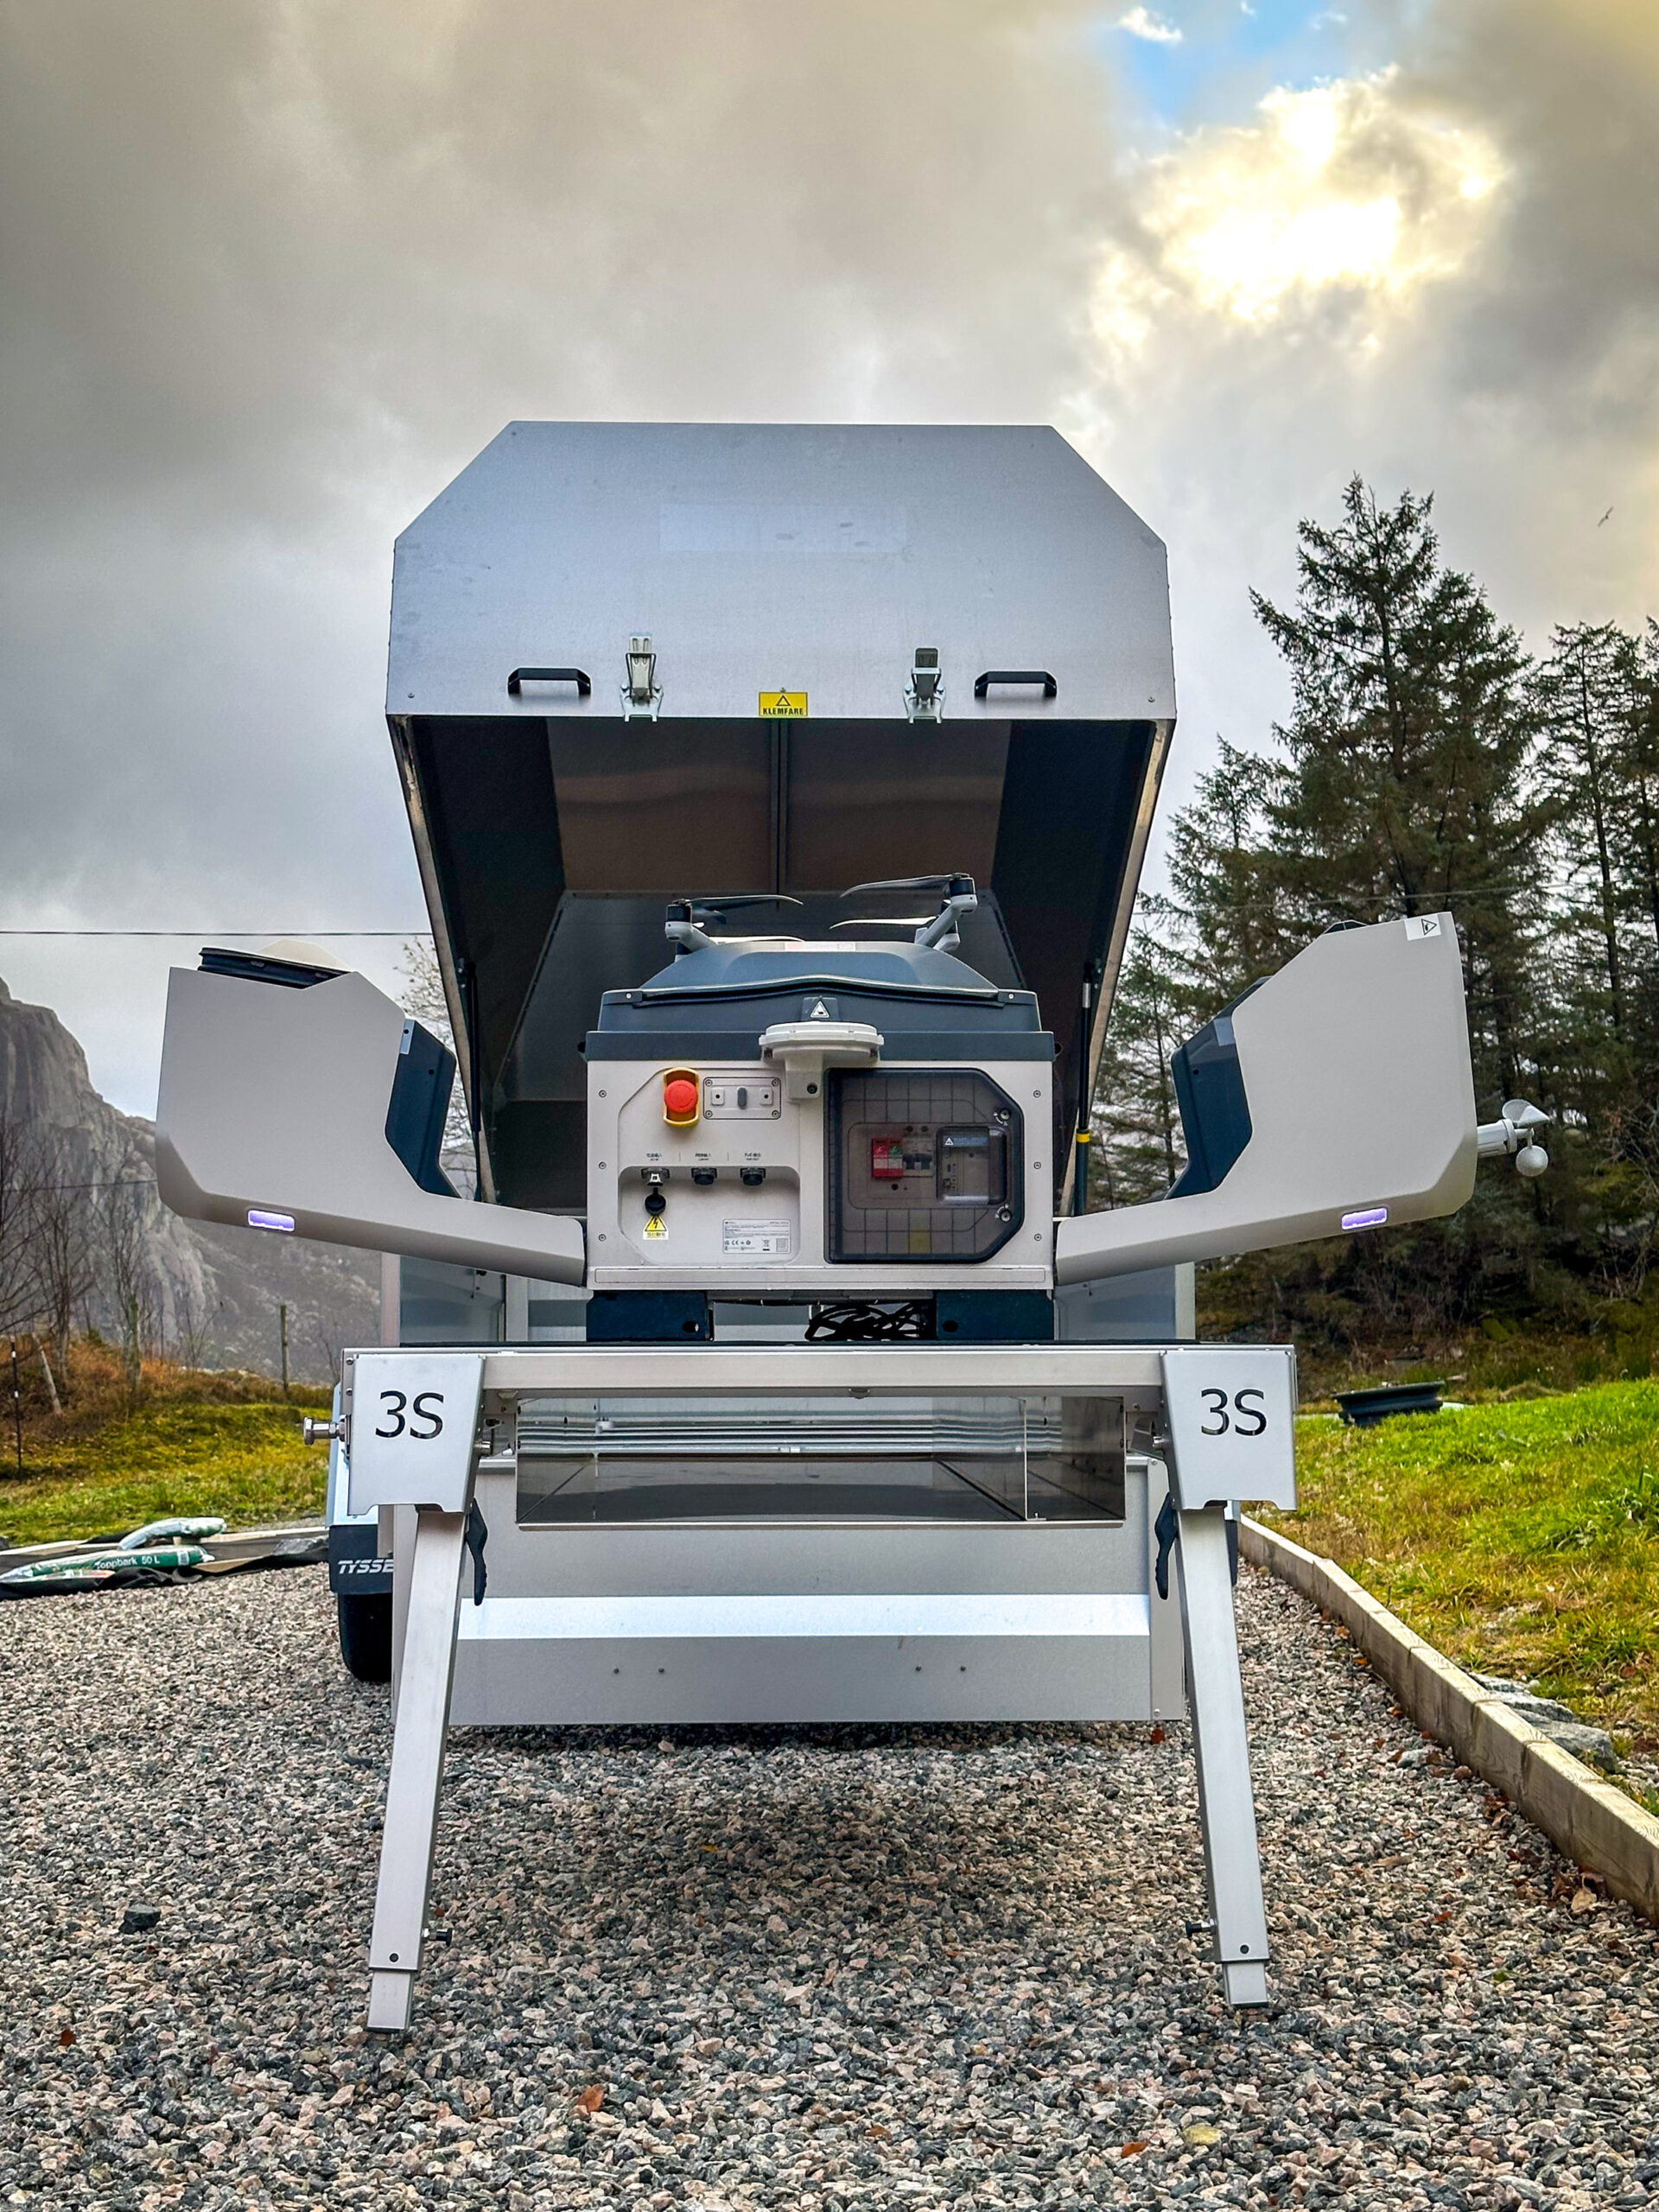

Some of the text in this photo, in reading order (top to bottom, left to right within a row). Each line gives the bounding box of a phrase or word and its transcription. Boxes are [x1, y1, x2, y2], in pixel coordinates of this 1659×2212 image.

[375, 1390, 444, 1440] 3S
[1201, 1388, 1267, 1436] 3S
[142, 1555, 152, 1565] 50
[154, 1554, 161, 1564] L
